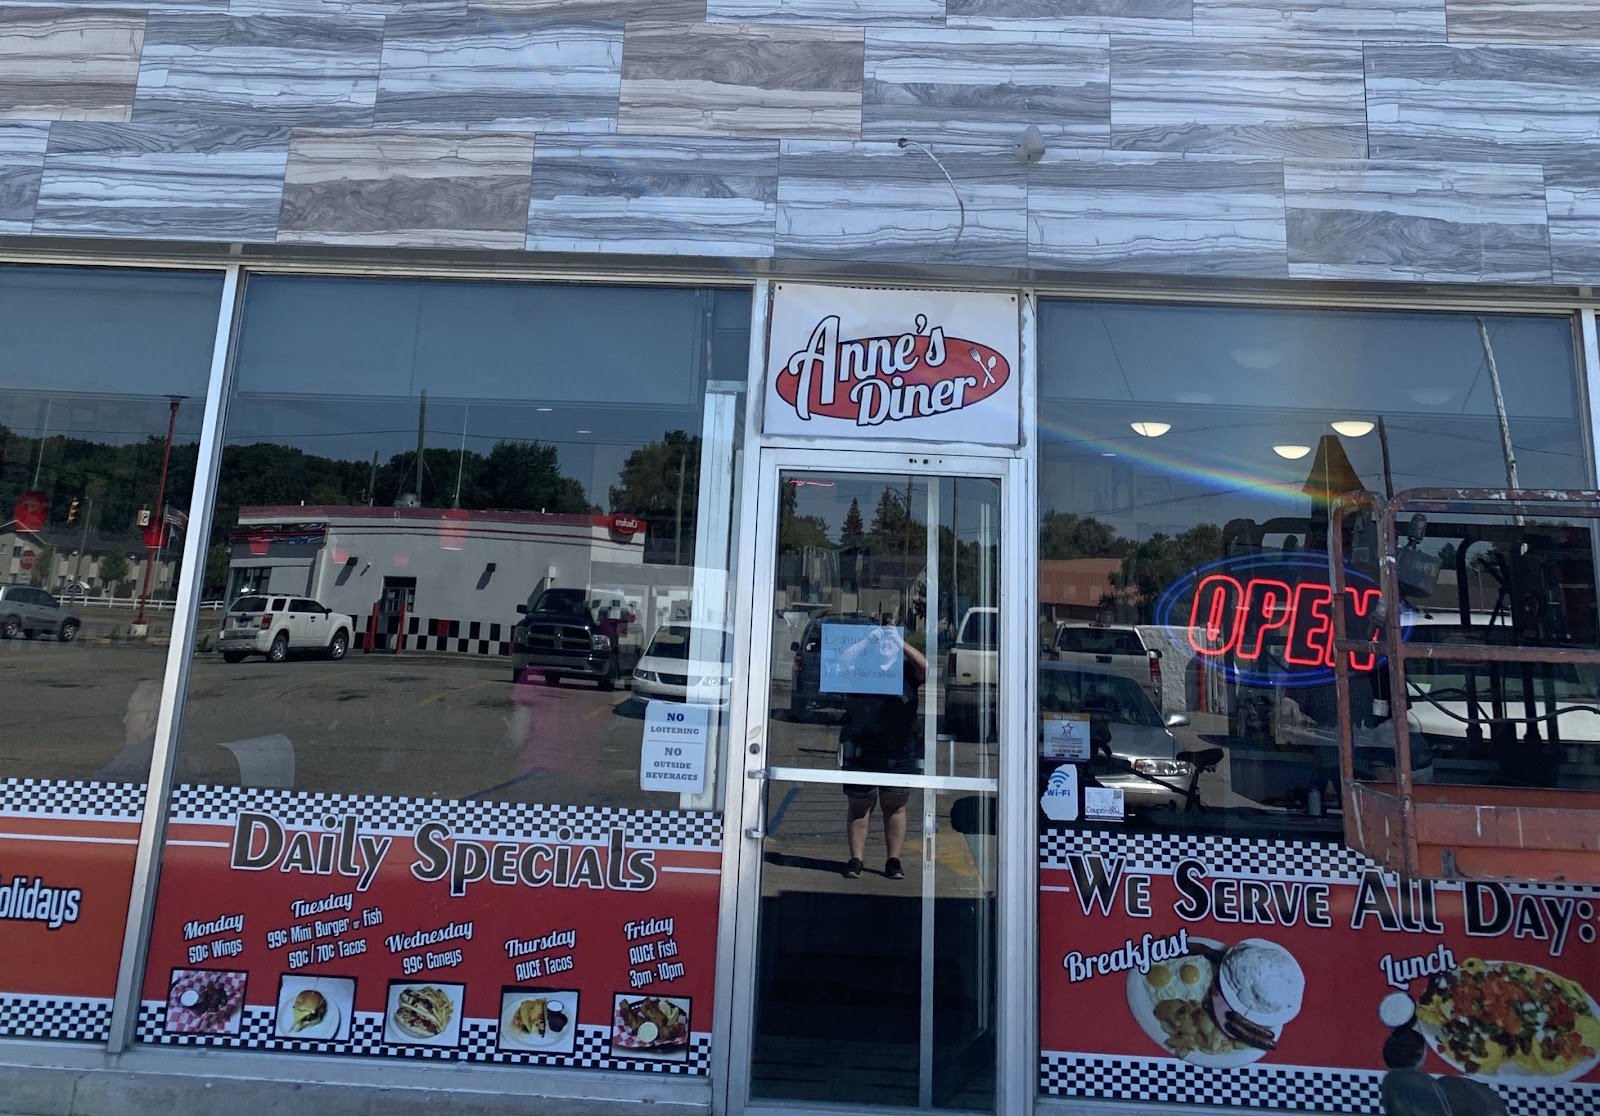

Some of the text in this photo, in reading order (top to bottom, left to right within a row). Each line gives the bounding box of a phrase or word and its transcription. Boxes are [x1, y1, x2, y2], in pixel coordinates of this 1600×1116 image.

[787, 313, 947, 420] Anne's
[849, 376, 977, 426] Diner
[1188, 575, 1385, 671] OPEN
[650, 725, 700, 735] LOITERING
[666, 712, 685, 722] NO
[664, 747, 682, 756] NO
[645, 771, 699, 781] BEVERAGES
[653, 761, 692, 769] OUTSIDE
[1047, 789, 1071, 797] Wi-Fi
[0, 877, 81, 928] olidays
[291, 893, 353, 918] Tuesday
[183, 913, 245, 940] Monday
[290, 923, 312, 944] Mini
[315, 918, 350, 937] Burger
[363, 907, 382, 927] Fish
[385, 920, 473, 953] Wednesday
[623, 916, 674, 941] Friday
[211, 939, 243, 959] Wings
[338, 939, 367, 958] Tacos
[504, 928, 576, 958] Thursday
[629, 939, 678, 965] AUCE Fish
[1063, 928, 1190, 982] Breakfast
[426, 948, 462, 968] Coneys
[515, 956, 573, 982] AUCE Tacos
[1379, 943, 1458, 991] Lunch
